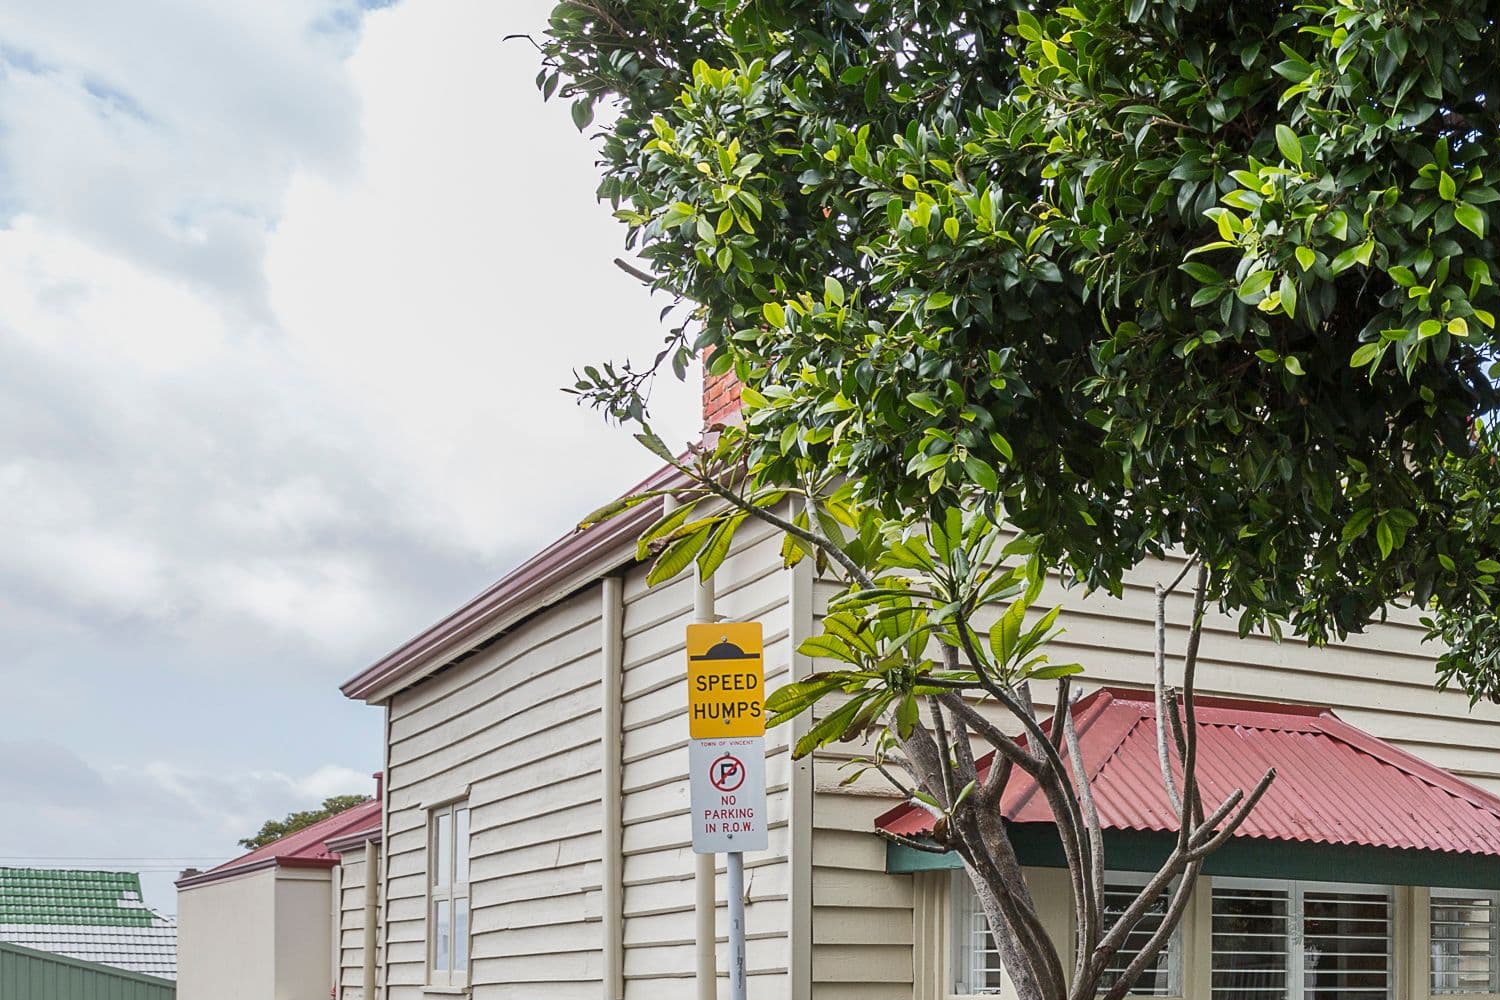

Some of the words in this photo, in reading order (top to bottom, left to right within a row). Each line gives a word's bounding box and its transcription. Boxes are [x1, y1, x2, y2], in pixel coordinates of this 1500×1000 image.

[696, 673, 758, 692] SPEED
[694, 700, 761, 719] HUMPS
[721, 795, 737, 806] NO
[704, 808, 754, 820] PARKING
[705, 823, 717, 833] IN
[722, 821, 755, 833] R.O.W.
